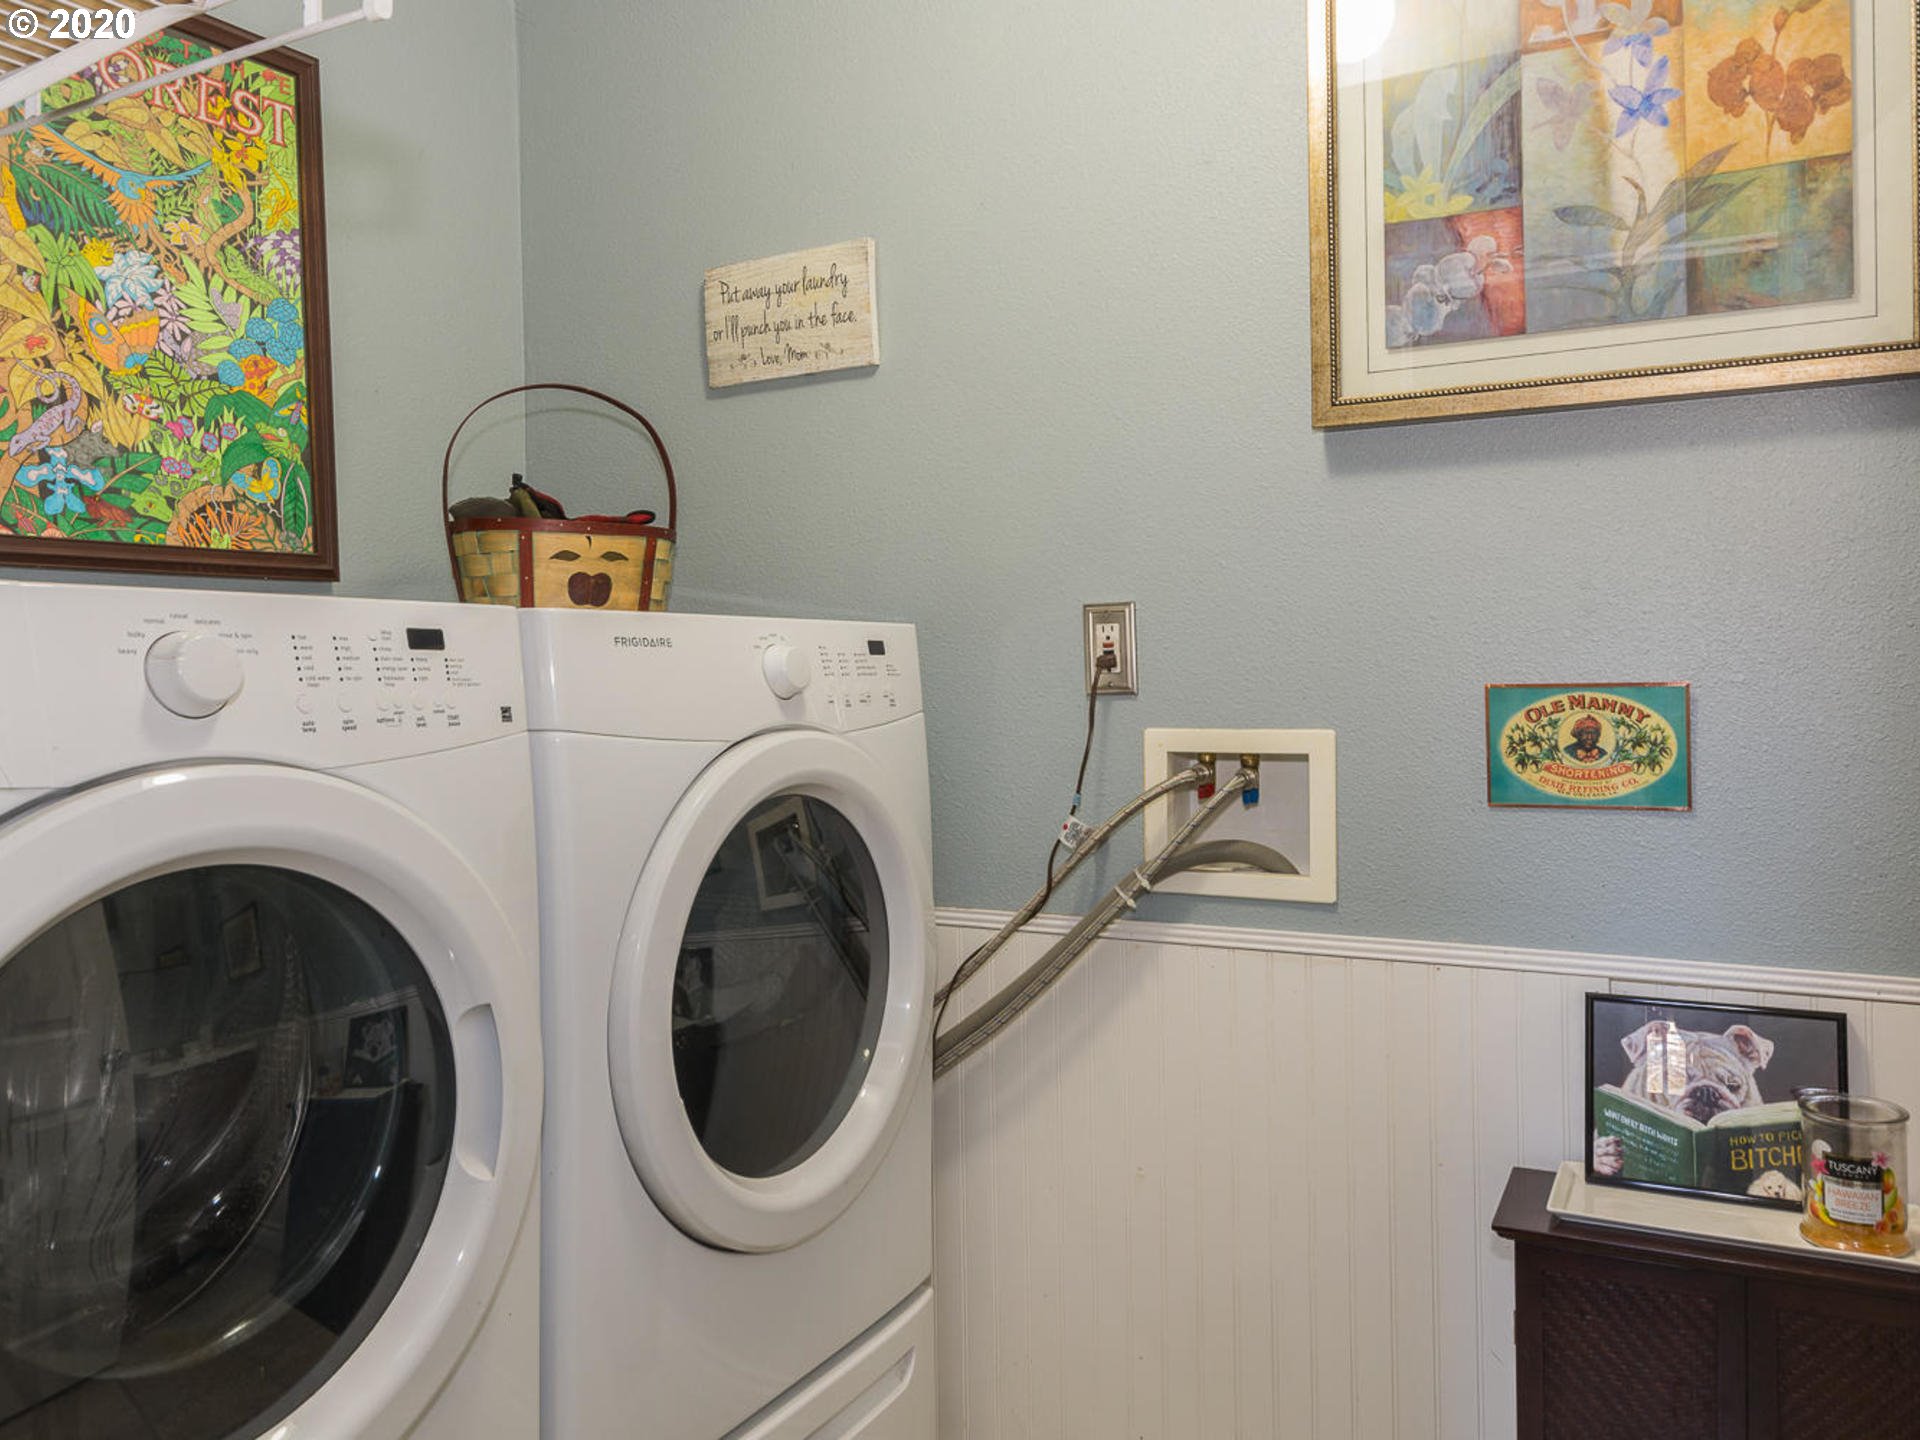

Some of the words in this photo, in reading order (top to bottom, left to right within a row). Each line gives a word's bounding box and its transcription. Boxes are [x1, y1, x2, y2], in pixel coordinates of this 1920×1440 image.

[97, 47, 297, 147] OREST
[718, 280, 740, 304] Put
[742, 286, 771, 309] away
[775, 280, 801, 308] your
[802, 262, 848, 298] laundry
[713, 329, 724, 342] or
[740, 309, 771, 349] punch
[772, 319, 791, 345] you
[794, 314, 805, 330] in
[808, 301, 828, 329] the
[831, 300, 857, 328] face.
[613, 635, 673, 649] FRIGIDAIRE
[1524, 700, 1566, 723] OLE
[1567, 694, 1651, 723] MAMMY
[1550, 763, 1626, 779] SHORTENING
[1569, 783, 1619, 793] REFINING
[1728, 1135, 1757, 1146] HOW
[1759, 1131, 1774, 1143] TO
[1778, 1130, 1802, 1142] PIC
[1828, 1160, 1879, 1176] TUSCANY
